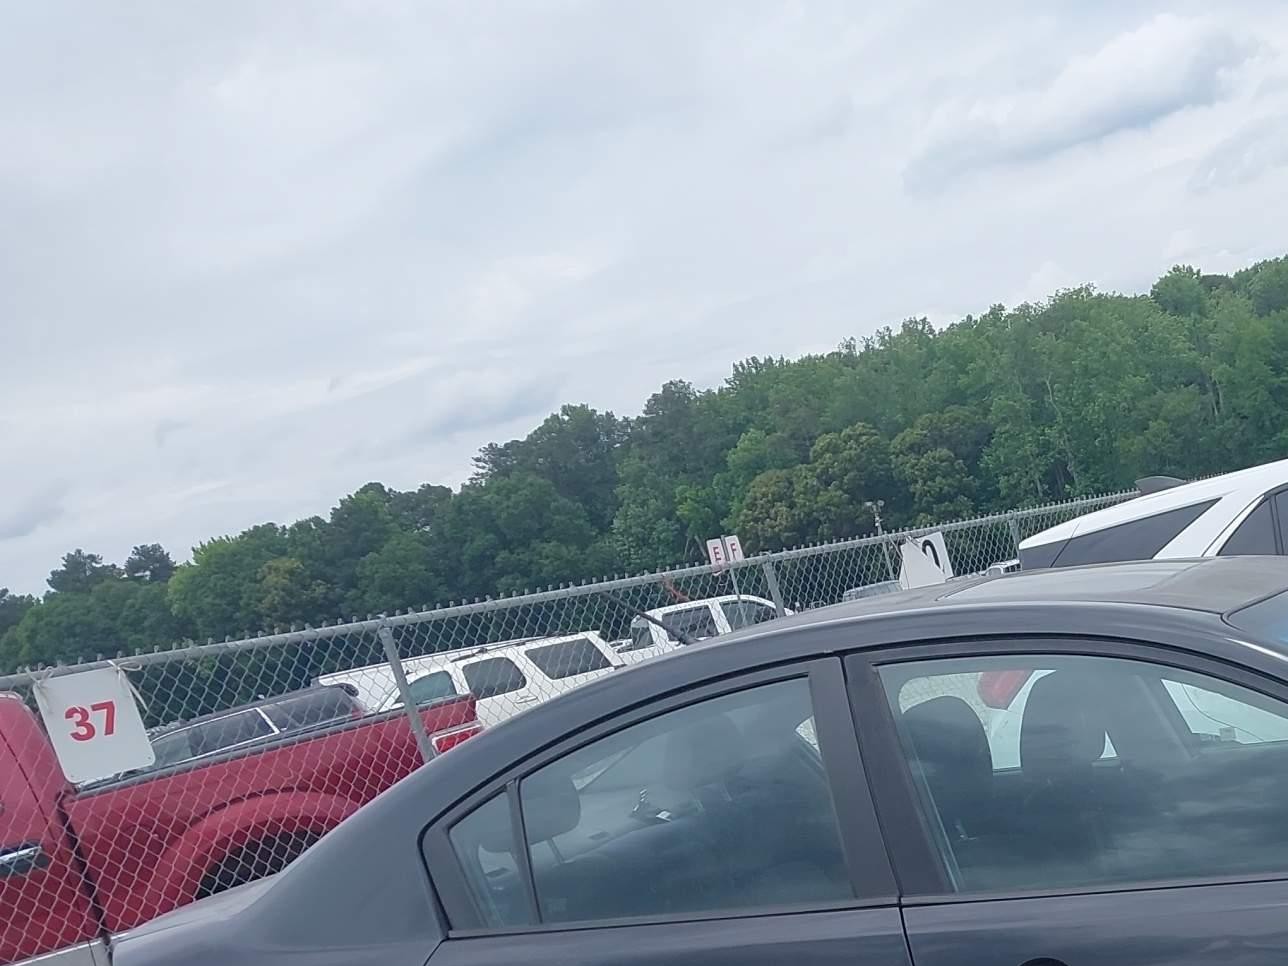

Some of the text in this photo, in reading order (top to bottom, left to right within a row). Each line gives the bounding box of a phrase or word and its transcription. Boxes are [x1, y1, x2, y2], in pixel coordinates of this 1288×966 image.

[712, 546, 721, 561] E
[730, 542, 737, 560] F
[64, 700, 115, 741] 37
